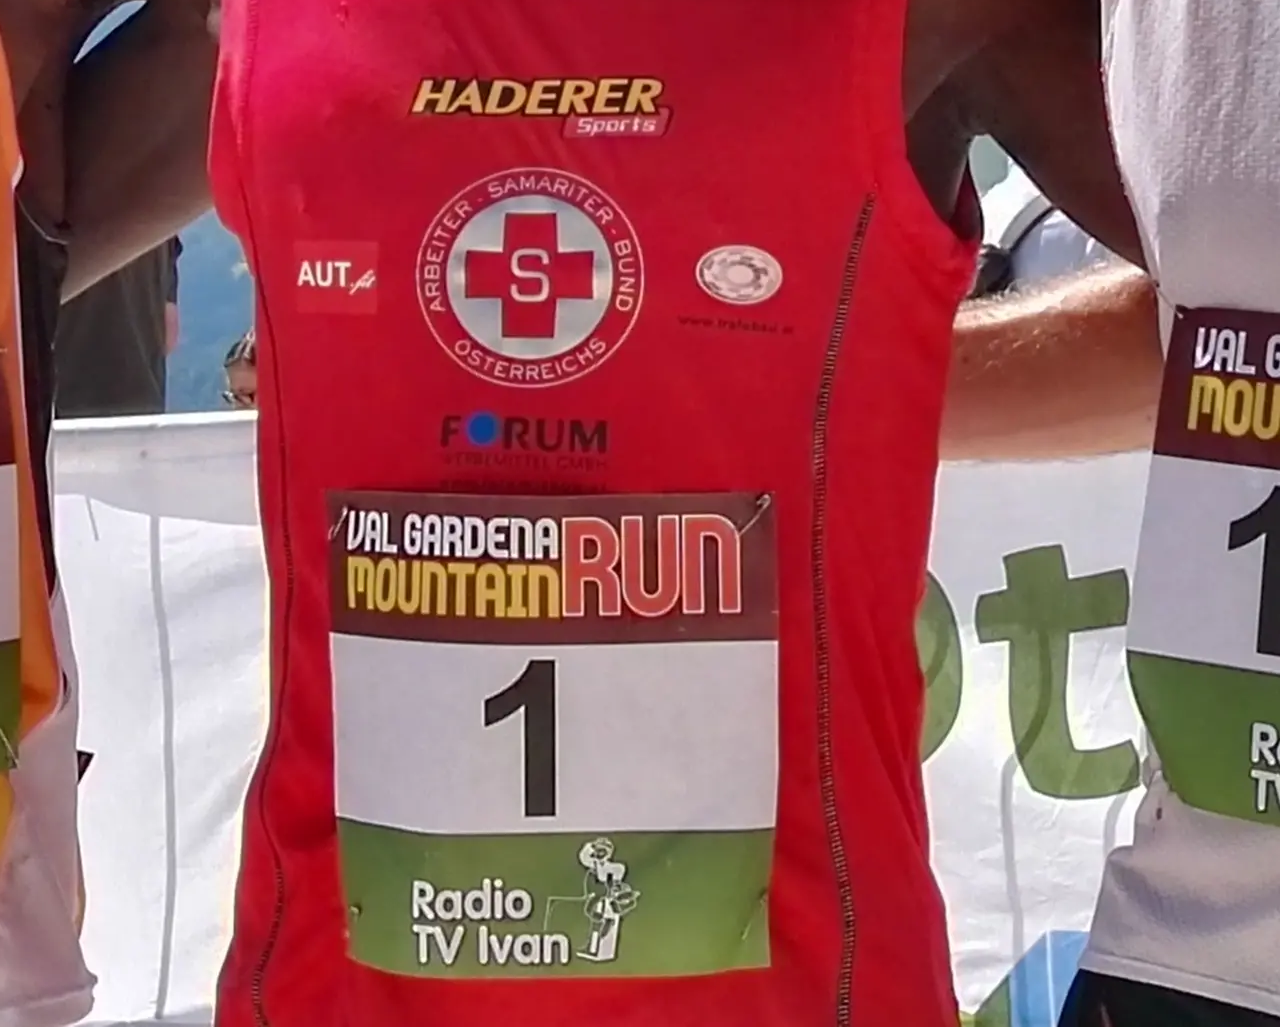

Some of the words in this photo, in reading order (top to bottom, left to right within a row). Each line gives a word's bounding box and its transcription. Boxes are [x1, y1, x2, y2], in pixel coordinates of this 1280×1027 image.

[411, 76, 664, 115] HADERER
[576, 117, 657, 137] Sports
[424, 199, 473, 313] ARBEITER
[487, 176, 614, 225] SAMARITER
[613, 239, 636, 312] BUND
[509, 248, 550, 302] S
[1193, 326, 1255, 376] VAL
[345, 510, 397, 555] VAL
[403, 513, 559, 559] GARDENA
[346, 557, 561, 618] MOUNTAIN
[560, 513, 742, 618] RUN
[483, 657, 558, 818] 1
[411, 878, 533, 921] Radio
[411, 925, 465, 966] TV
[476, 925, 570, 965] Ivan
